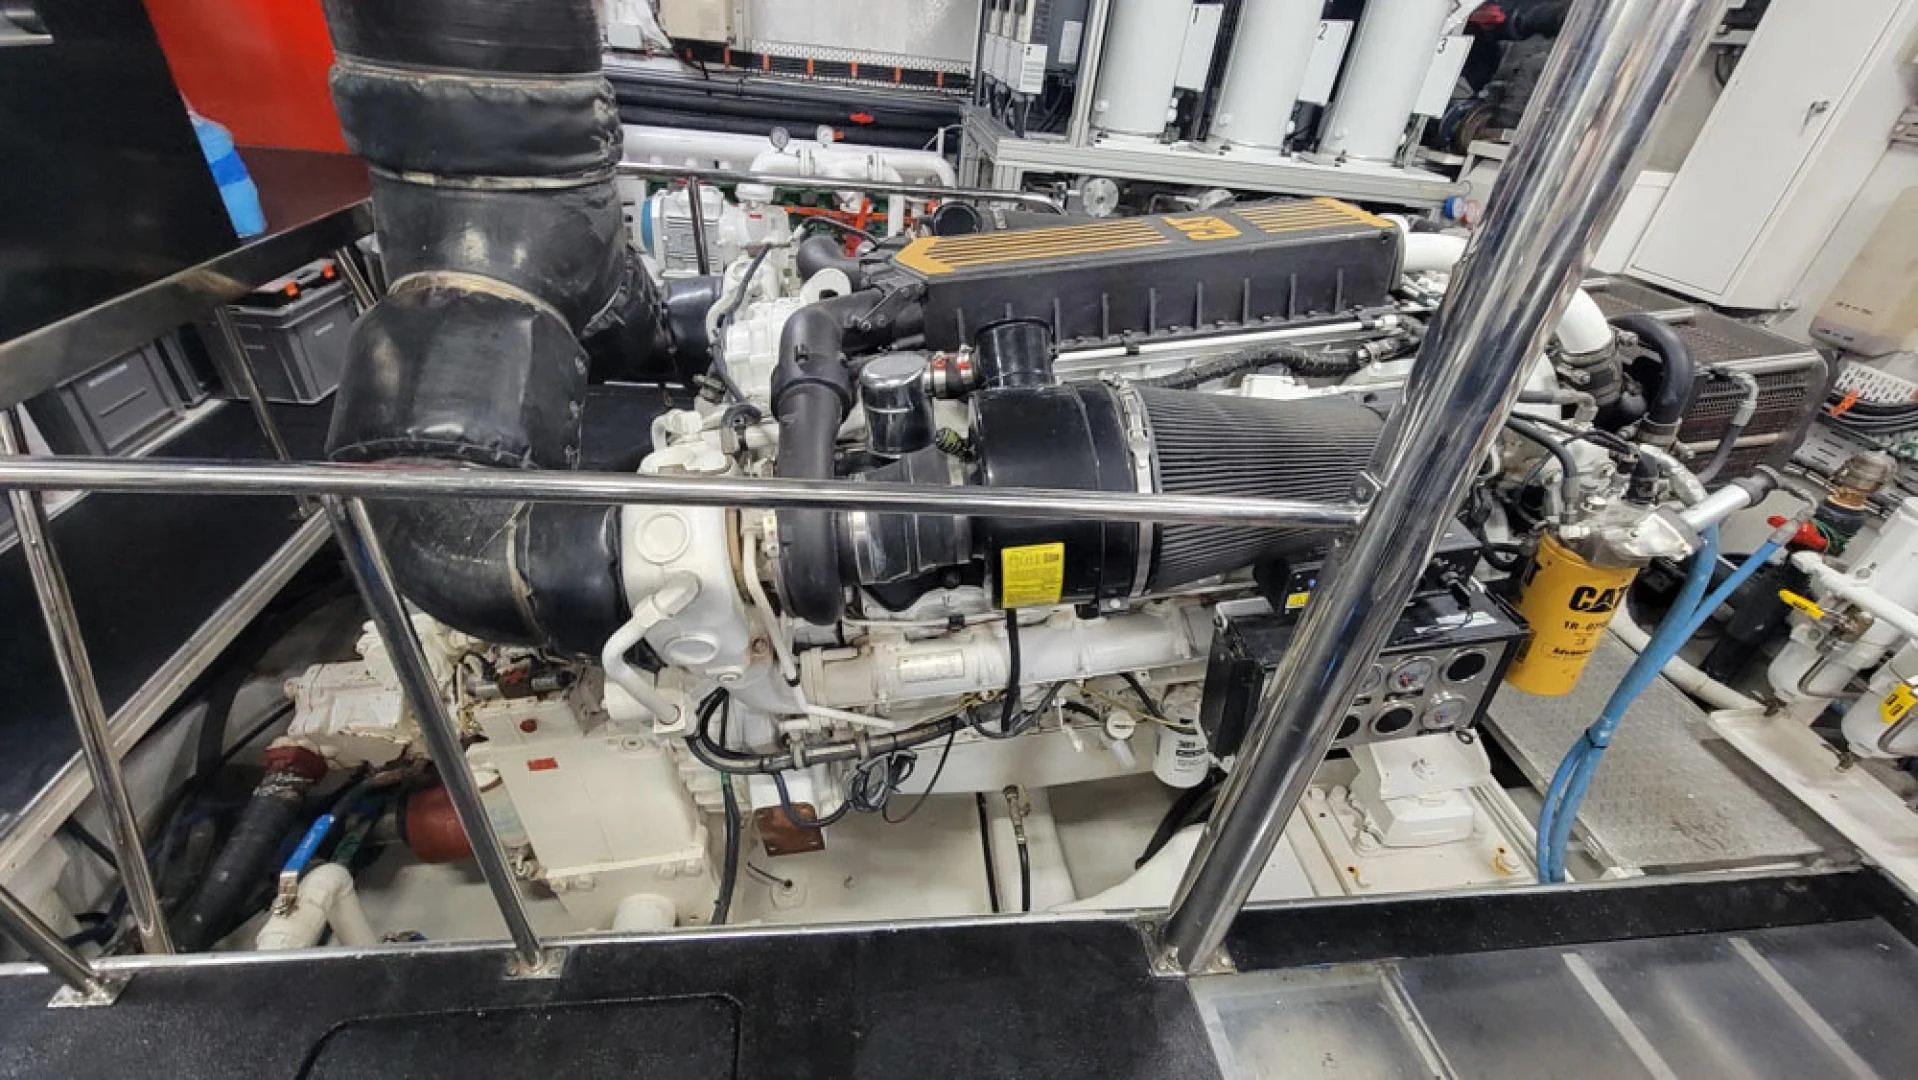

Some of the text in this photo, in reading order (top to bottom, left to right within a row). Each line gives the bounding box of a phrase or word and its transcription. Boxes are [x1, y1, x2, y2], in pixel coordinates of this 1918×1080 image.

[1192, 7, 1200, 24] 1
[1317, 23, 1329, 40] 2
[1437, 37, 1449, 54] 3
